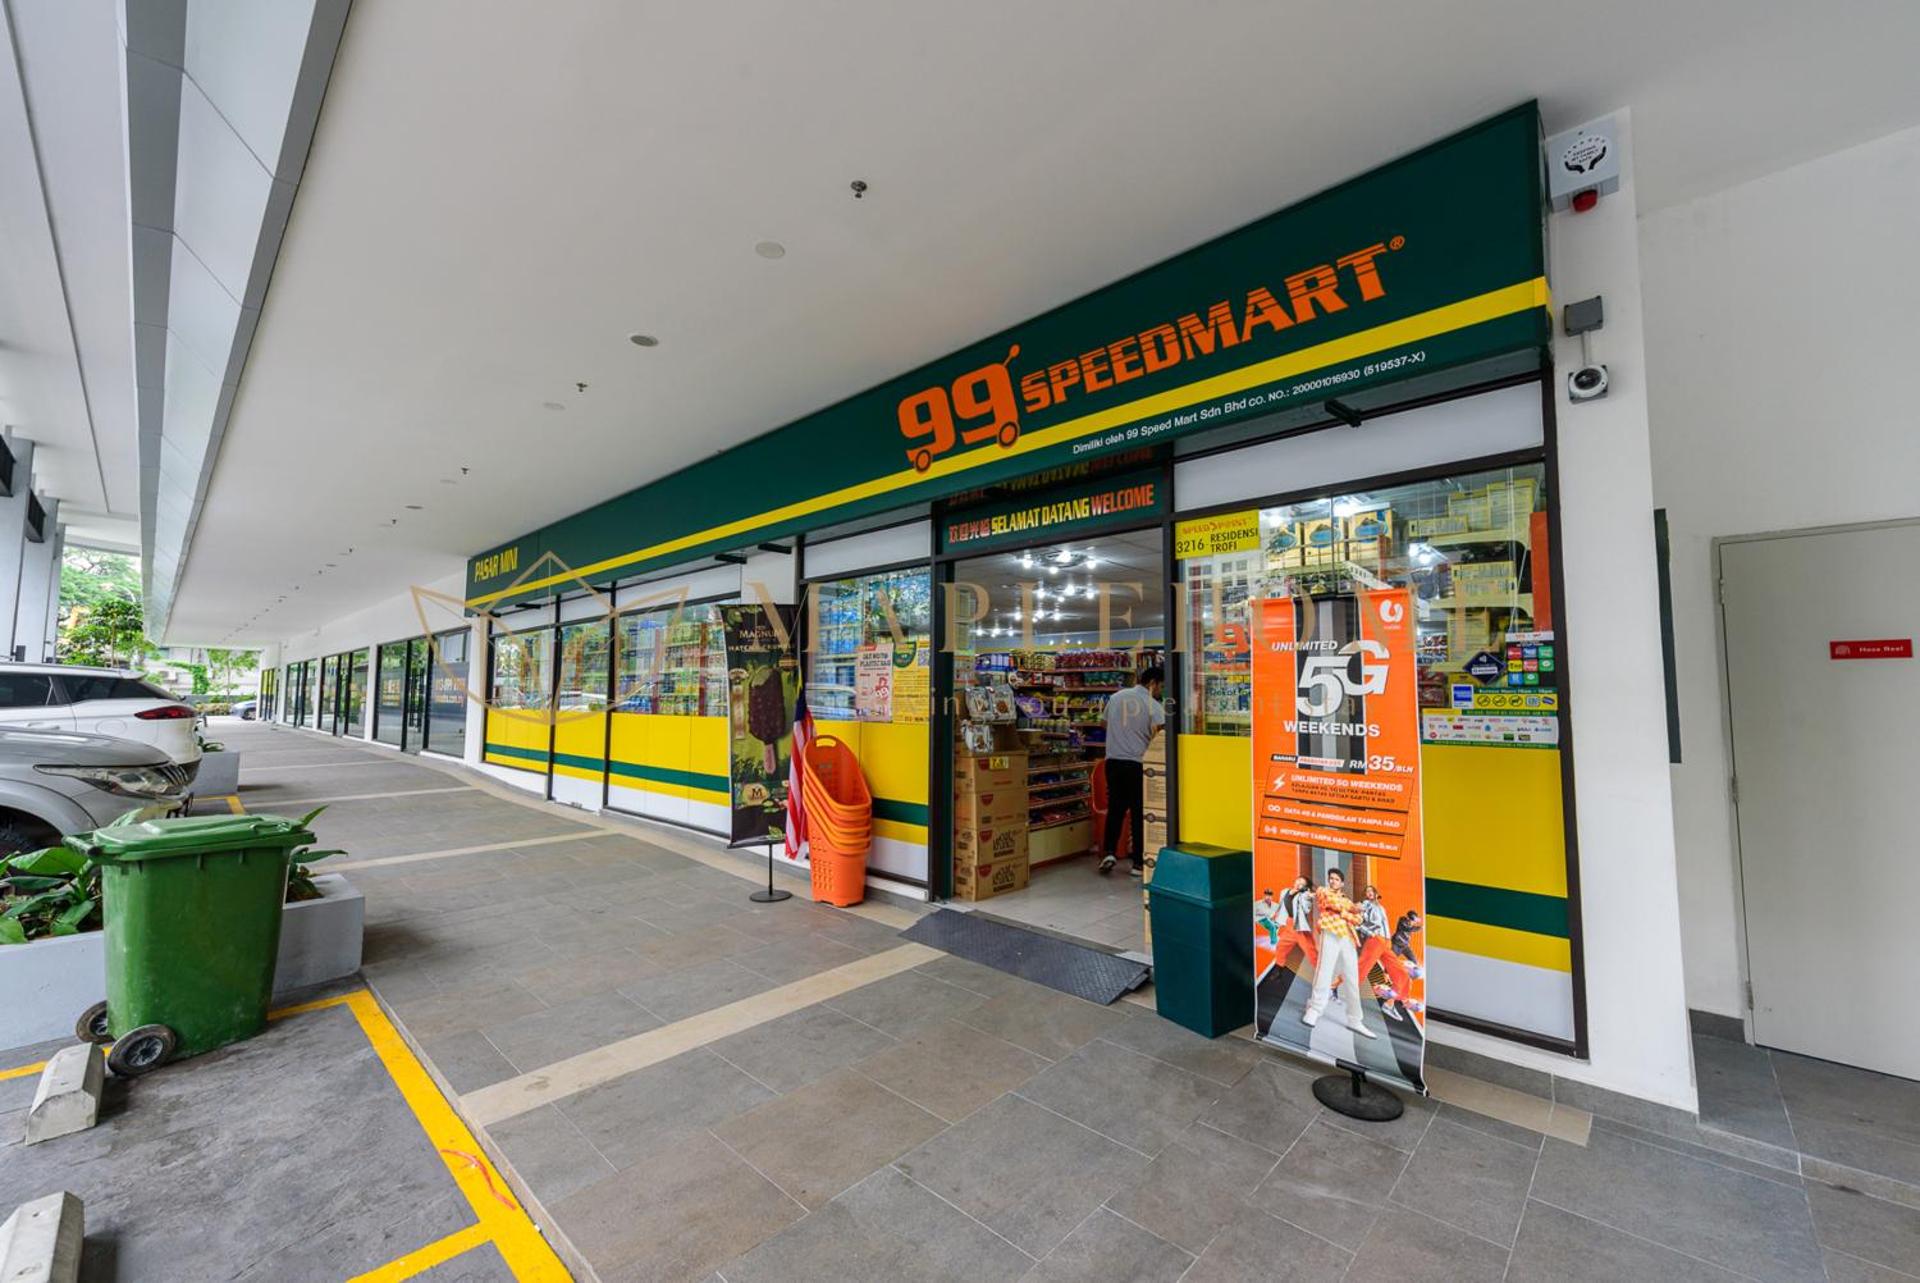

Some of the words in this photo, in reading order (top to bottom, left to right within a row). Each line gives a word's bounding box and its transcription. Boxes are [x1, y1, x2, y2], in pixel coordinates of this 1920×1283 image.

[898, 344, 1020, 474] 99
[1021, 242, 1388, 413] SPEEDMART
[1126, 429, 1138, 441] 99
[1141, 419, 1173, 439] Speed
[1175, 411, 1198, 428] Mart
[1200, 404, 1222, 421] Sdn
[1224, 397, 1247, 415] Bhd
[1090, 483, 1154, 517] WELCOME
[991, 508, 1040, 535] SELAMAT
[1042, 497, 1090, 527] DATANG
[1176, 539, 1205, 553] 3216
[1210, 527, 1258, 543] RESIDENSI
[1210, 541, 1238, 553] TROFI
[1271, 640, 1338, 651] UNLIMITED
[1296, 639, 1391, 717] 5G
[1283, 720, 1381, 737] WEEKENDS
